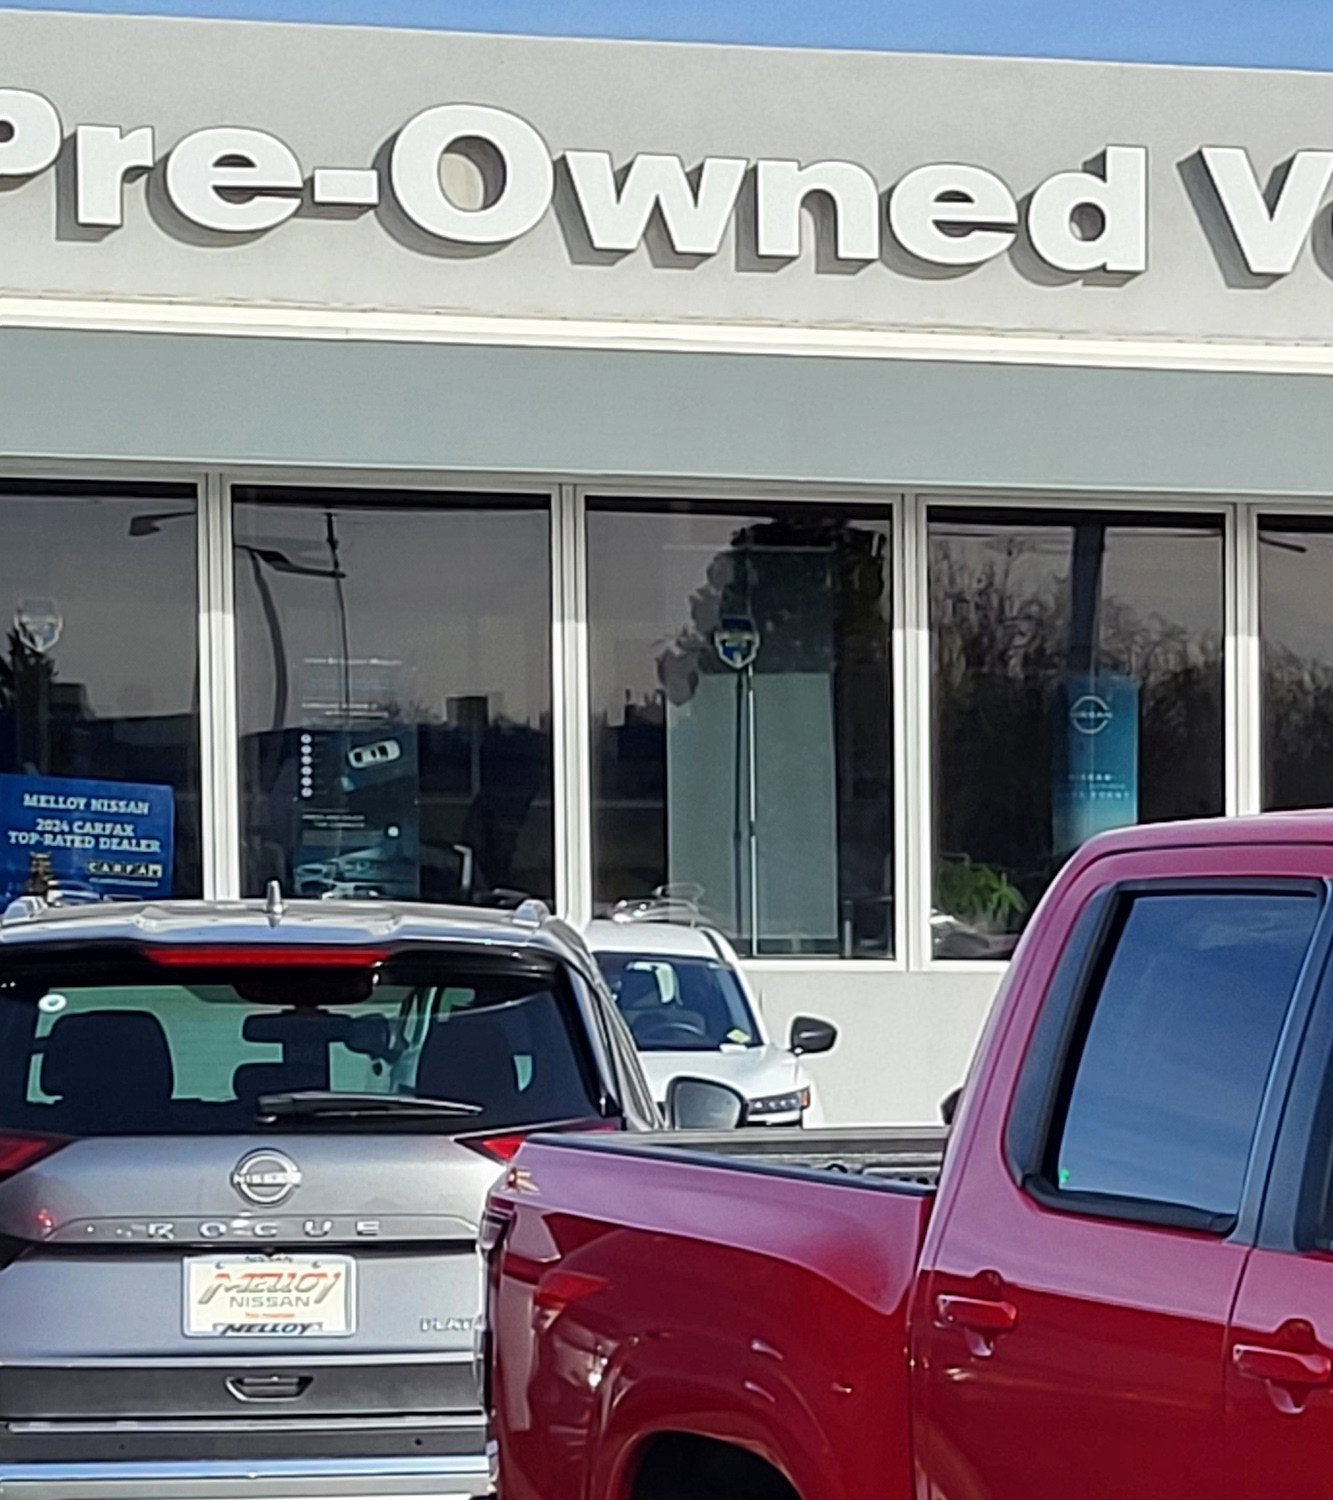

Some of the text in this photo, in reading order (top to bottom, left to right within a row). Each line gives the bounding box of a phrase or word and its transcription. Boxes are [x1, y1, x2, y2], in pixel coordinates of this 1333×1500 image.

[23, 793, 149, 815] MELLOY NISSAN
[72, 821, 135, 837] CARFAX
[8, 831, 161, 852] TOP-RATED DEALER
[148, 1220, 380, 1240] ROGUE
[229, 1296, 310, 1308] NISSAN
